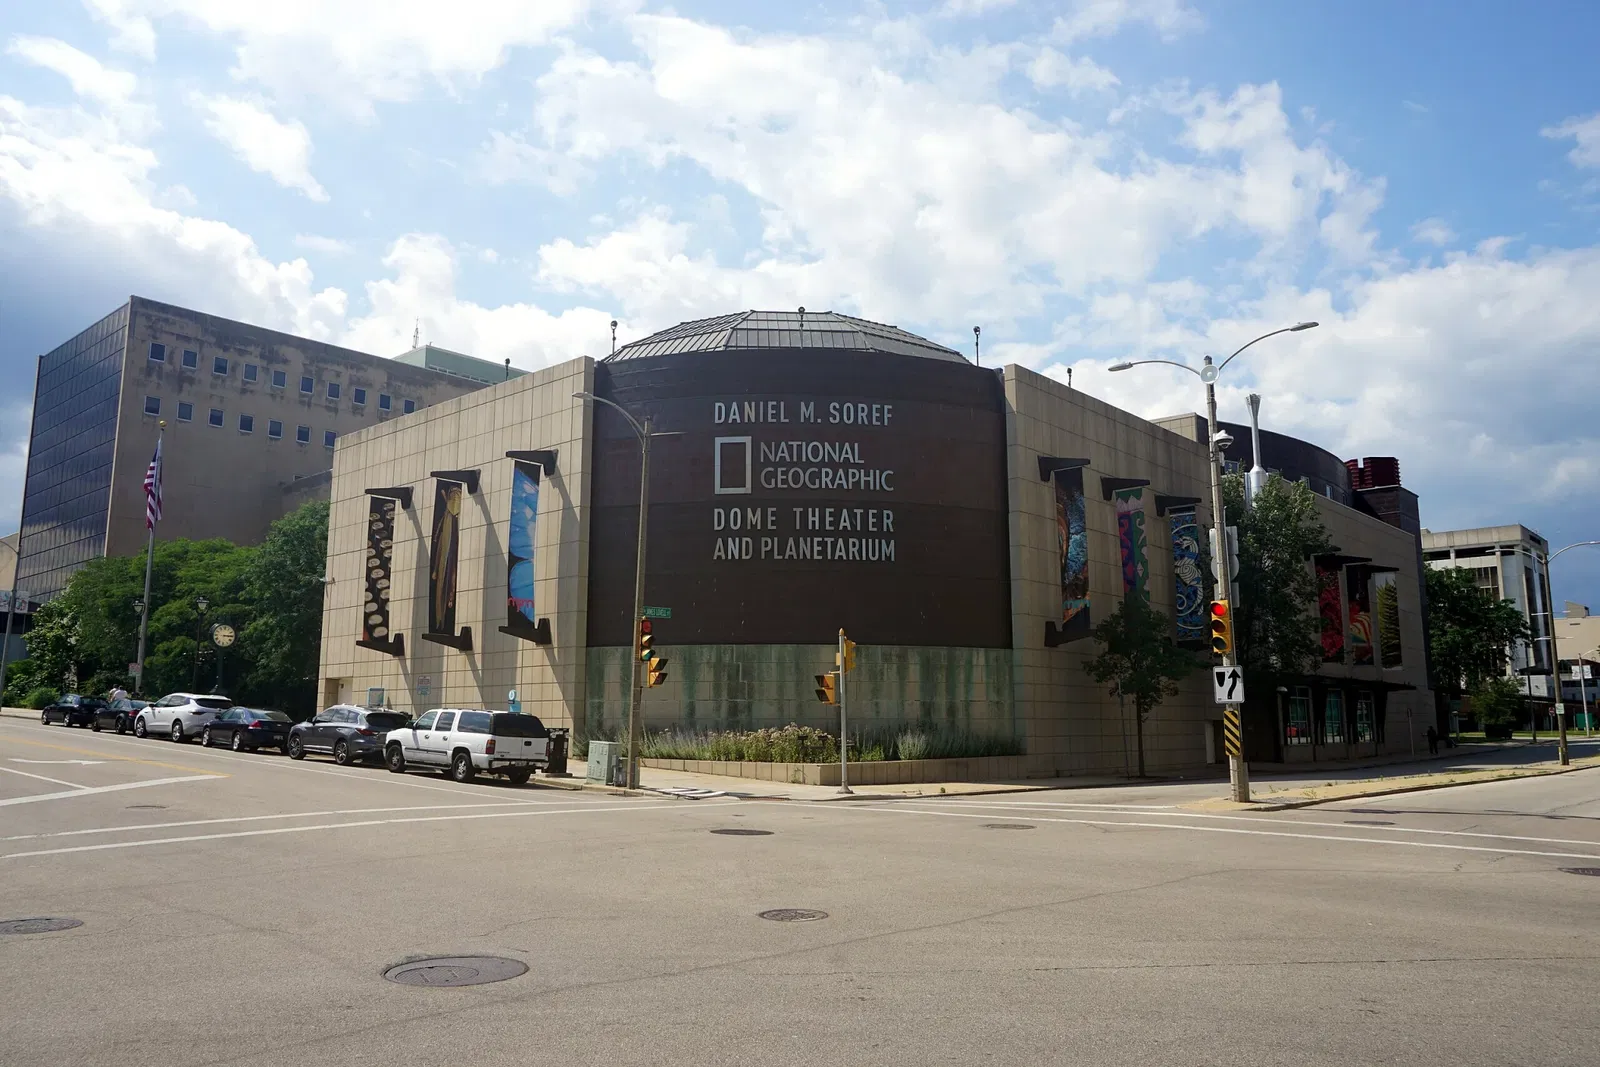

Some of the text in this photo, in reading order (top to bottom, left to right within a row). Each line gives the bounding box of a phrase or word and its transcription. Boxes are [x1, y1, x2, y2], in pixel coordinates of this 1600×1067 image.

[714, 401, 893, 426] DANIEL M. SOREF
[760, 441, 865, 464] NATIONAL
[760, 467, 894, 491] GEOGRAPHIC
[713, 507, 894, 532] DOME THEATER
[713, 537, 895, 562] AND PLANETARIUM
